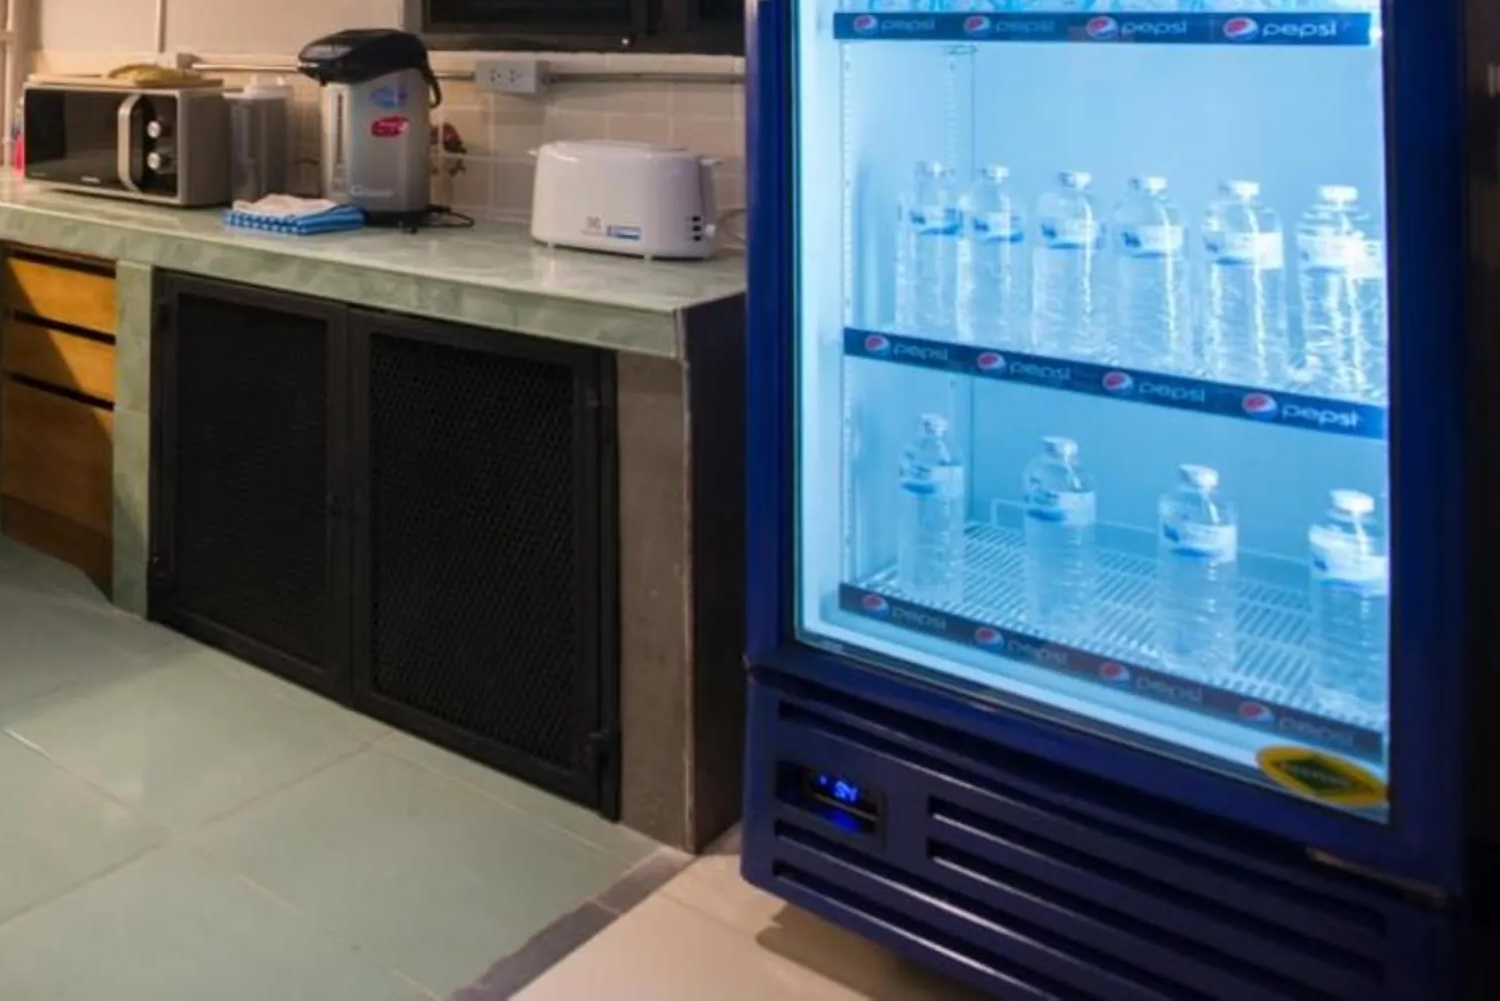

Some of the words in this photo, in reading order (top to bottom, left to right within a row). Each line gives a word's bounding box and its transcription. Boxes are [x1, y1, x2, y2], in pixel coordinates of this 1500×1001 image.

[1121, 19, 1187, 36] pepsi
[1262, 20, 1337, 37] pepsi
[1138, 382, 1205, 404] pepsi
[1281, 403, 1360, 428] pepsi
